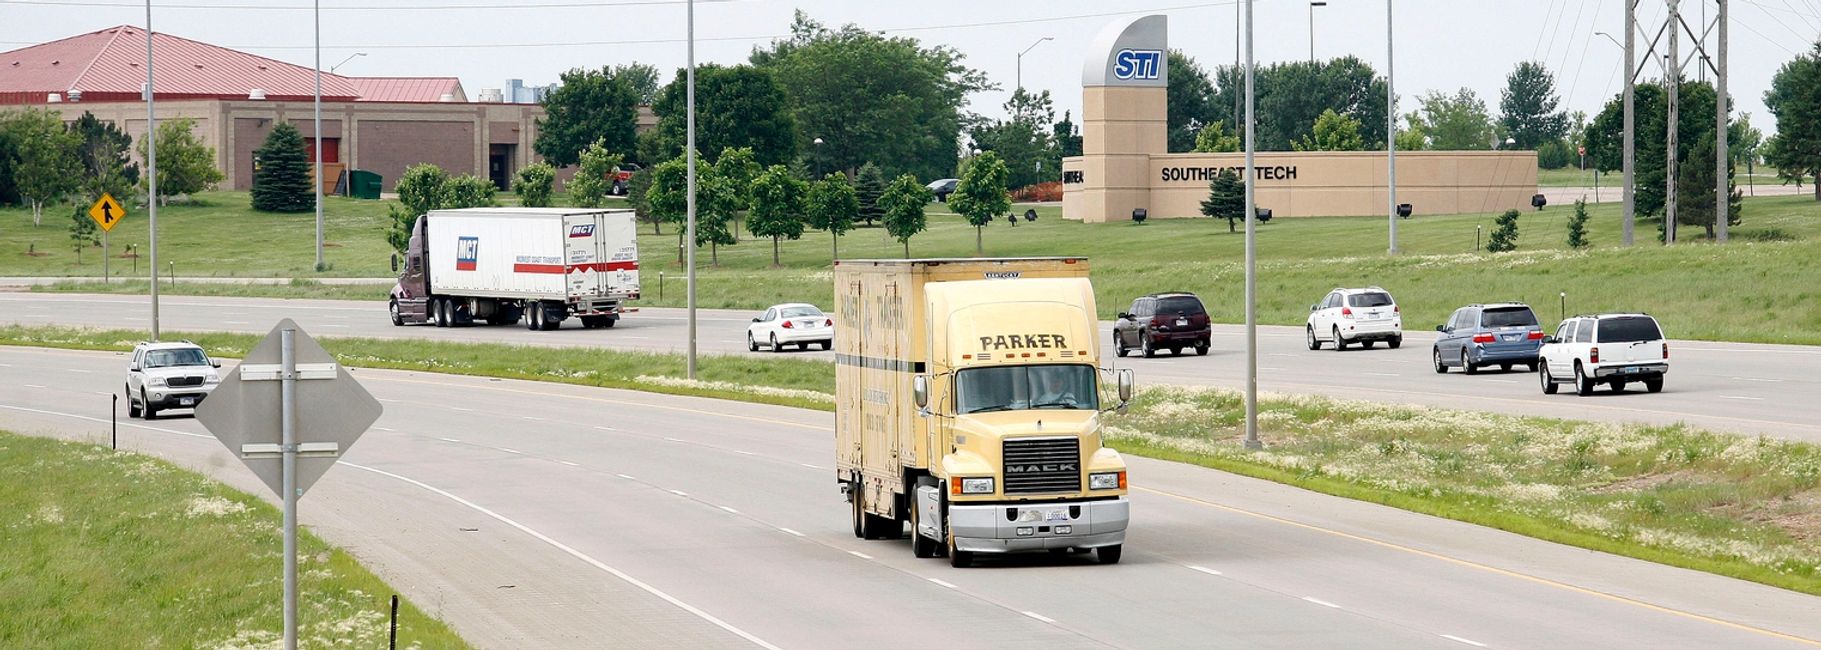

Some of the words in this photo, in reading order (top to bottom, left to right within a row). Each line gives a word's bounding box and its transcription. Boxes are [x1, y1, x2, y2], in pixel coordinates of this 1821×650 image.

[1114, 49, 1162, 79] STI
[1254, 165, 1297, 180] TECH
[571, 225, 594, 235] MCT
[458, 239, 478, 259] MCT
[980, 334, 1067, 351] PARKER
[1006, 463, 1076, 473] MACK
